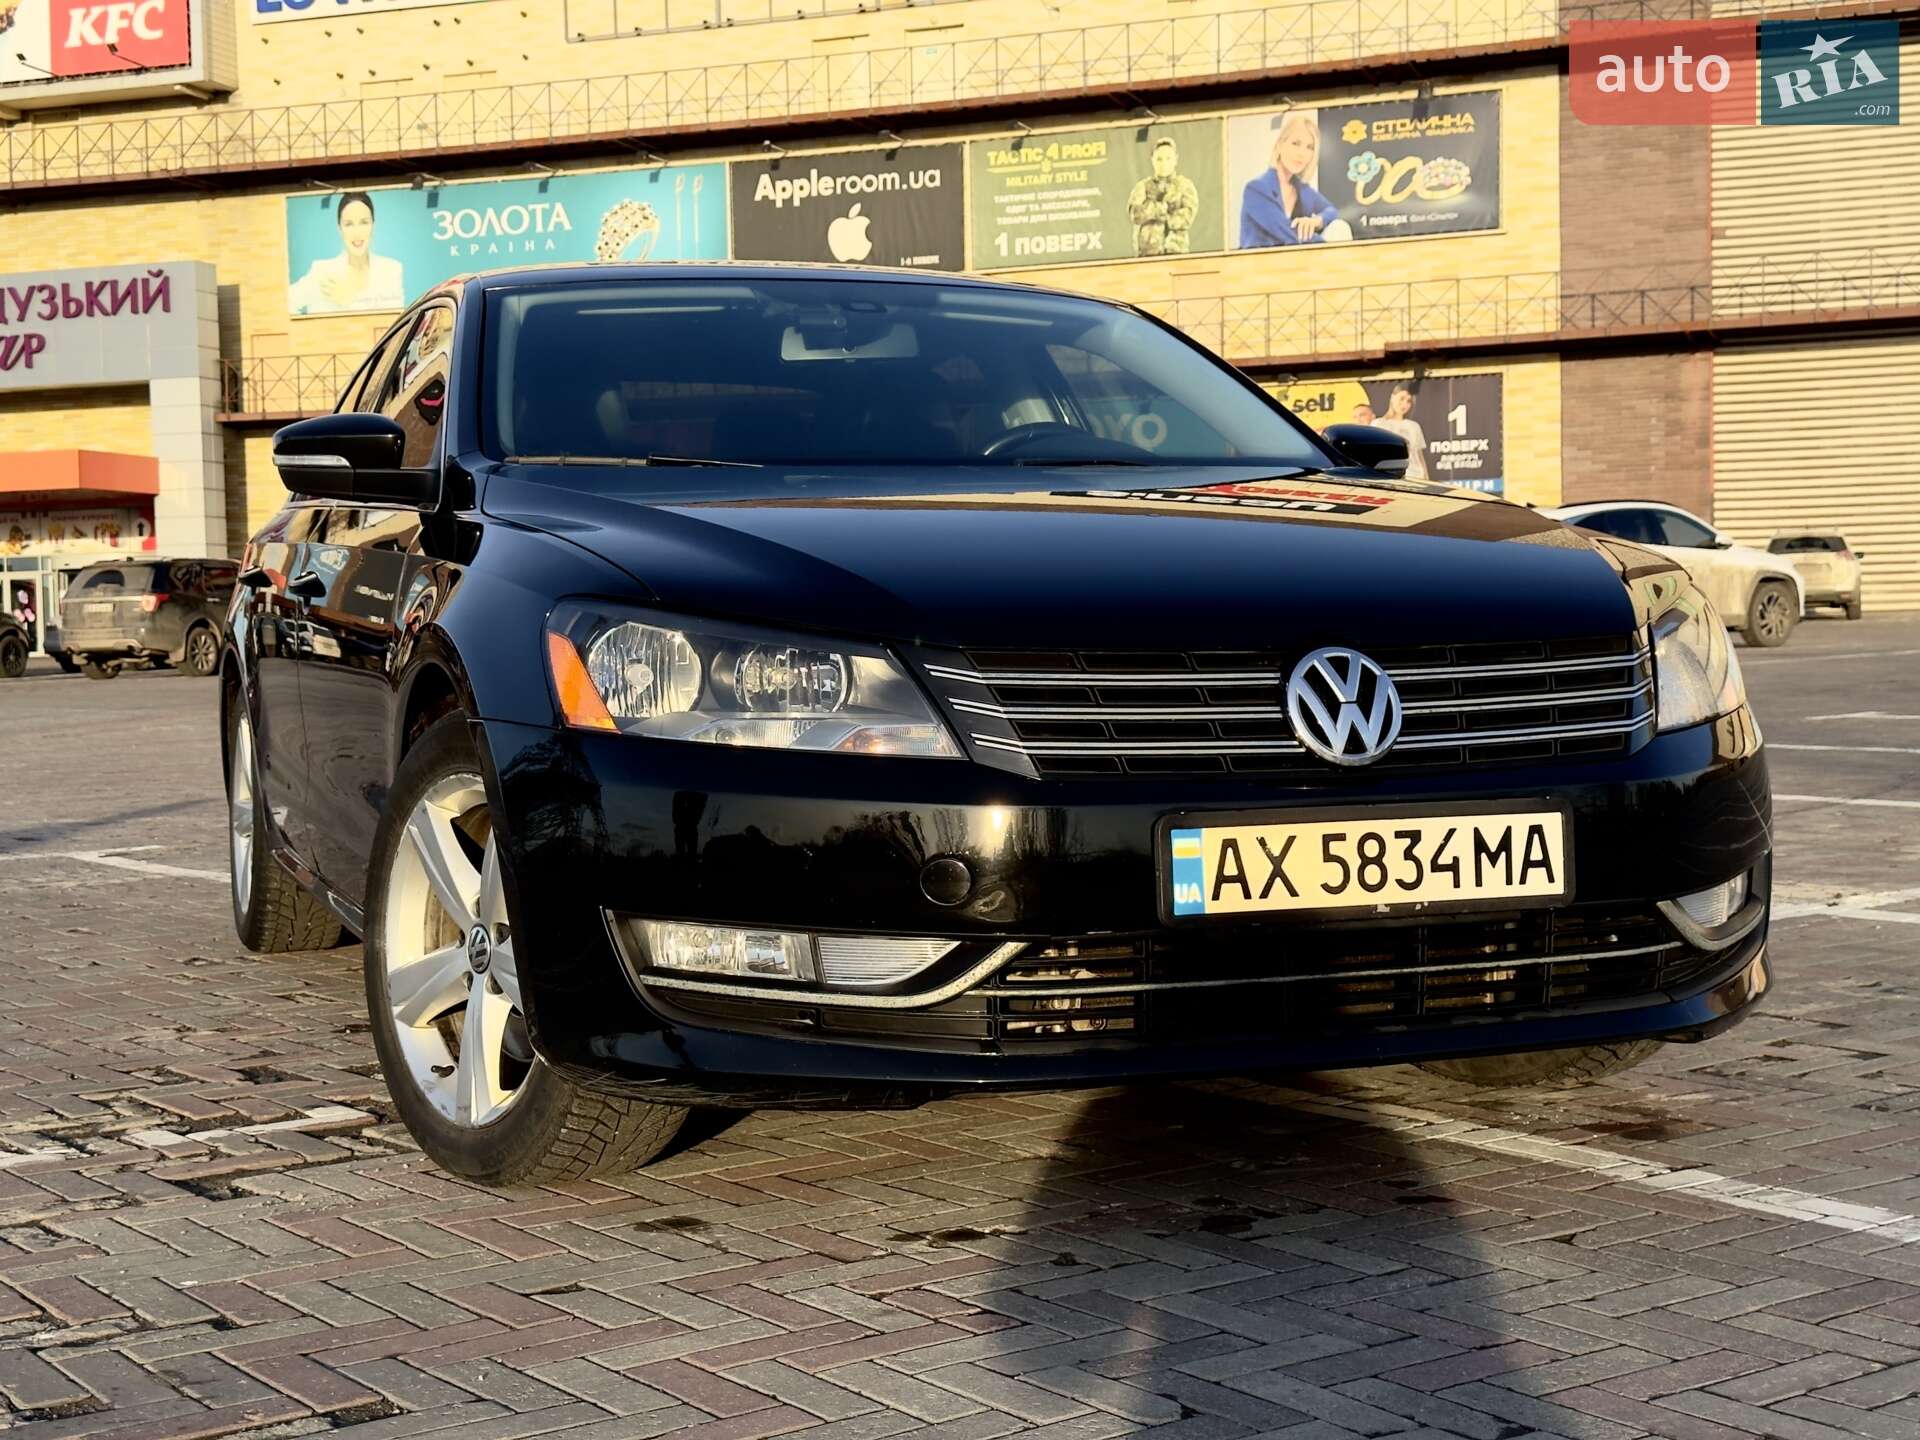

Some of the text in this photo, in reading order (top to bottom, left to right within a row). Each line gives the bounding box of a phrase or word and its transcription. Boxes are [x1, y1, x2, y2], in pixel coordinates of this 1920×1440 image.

[64, 0, 165, 48] KFC
[986, 141, 1106, 166] TACTIC 4 PROFI
[754, 168, 941, 208] Appleroom.ua
[1006, 170, 1088, 188] MILITARY STYLE
[432, 202, 573, 240] ЗОЛОТА
[994, 231, 1103, 257] 1 ПОВЕРХ
[1448, 404, 1468, 436] 1
[1430, 438, 1489, 453] ПОВЕРХ
[1211, 834, 1300, 902] AX
[1320, 827, 1461, 895] 5834
[1174, 882, 1202, 904] UA
